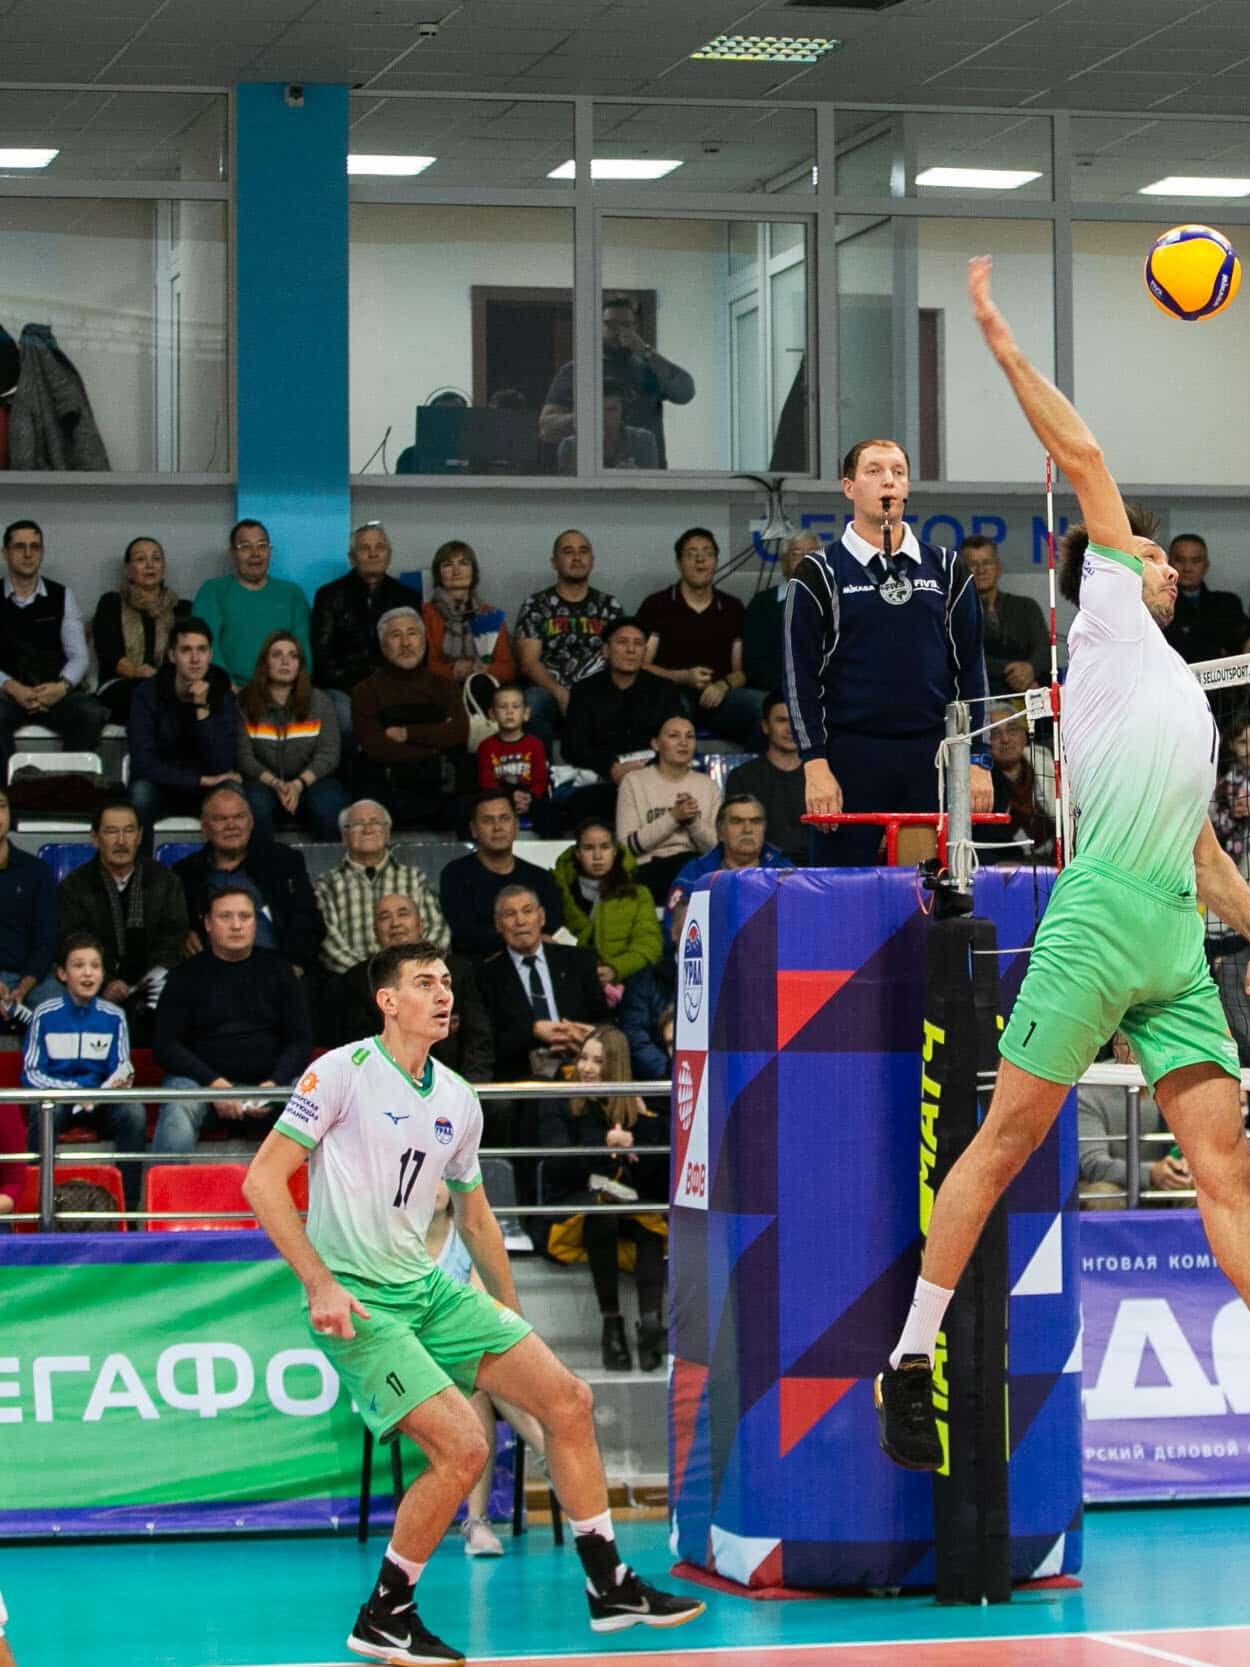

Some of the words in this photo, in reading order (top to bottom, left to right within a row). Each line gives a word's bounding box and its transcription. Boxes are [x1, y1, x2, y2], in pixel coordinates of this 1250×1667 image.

[1022, 1020, 1037, 1048] 1
[393, 1147, 427, 1210] 17
[1168, 1253, 1218, 1270] КОМ
[0, 1342, 359, 1423] ГАФО
[1154, 1439, 1239, 1461] ДЕЛОВОЙ
